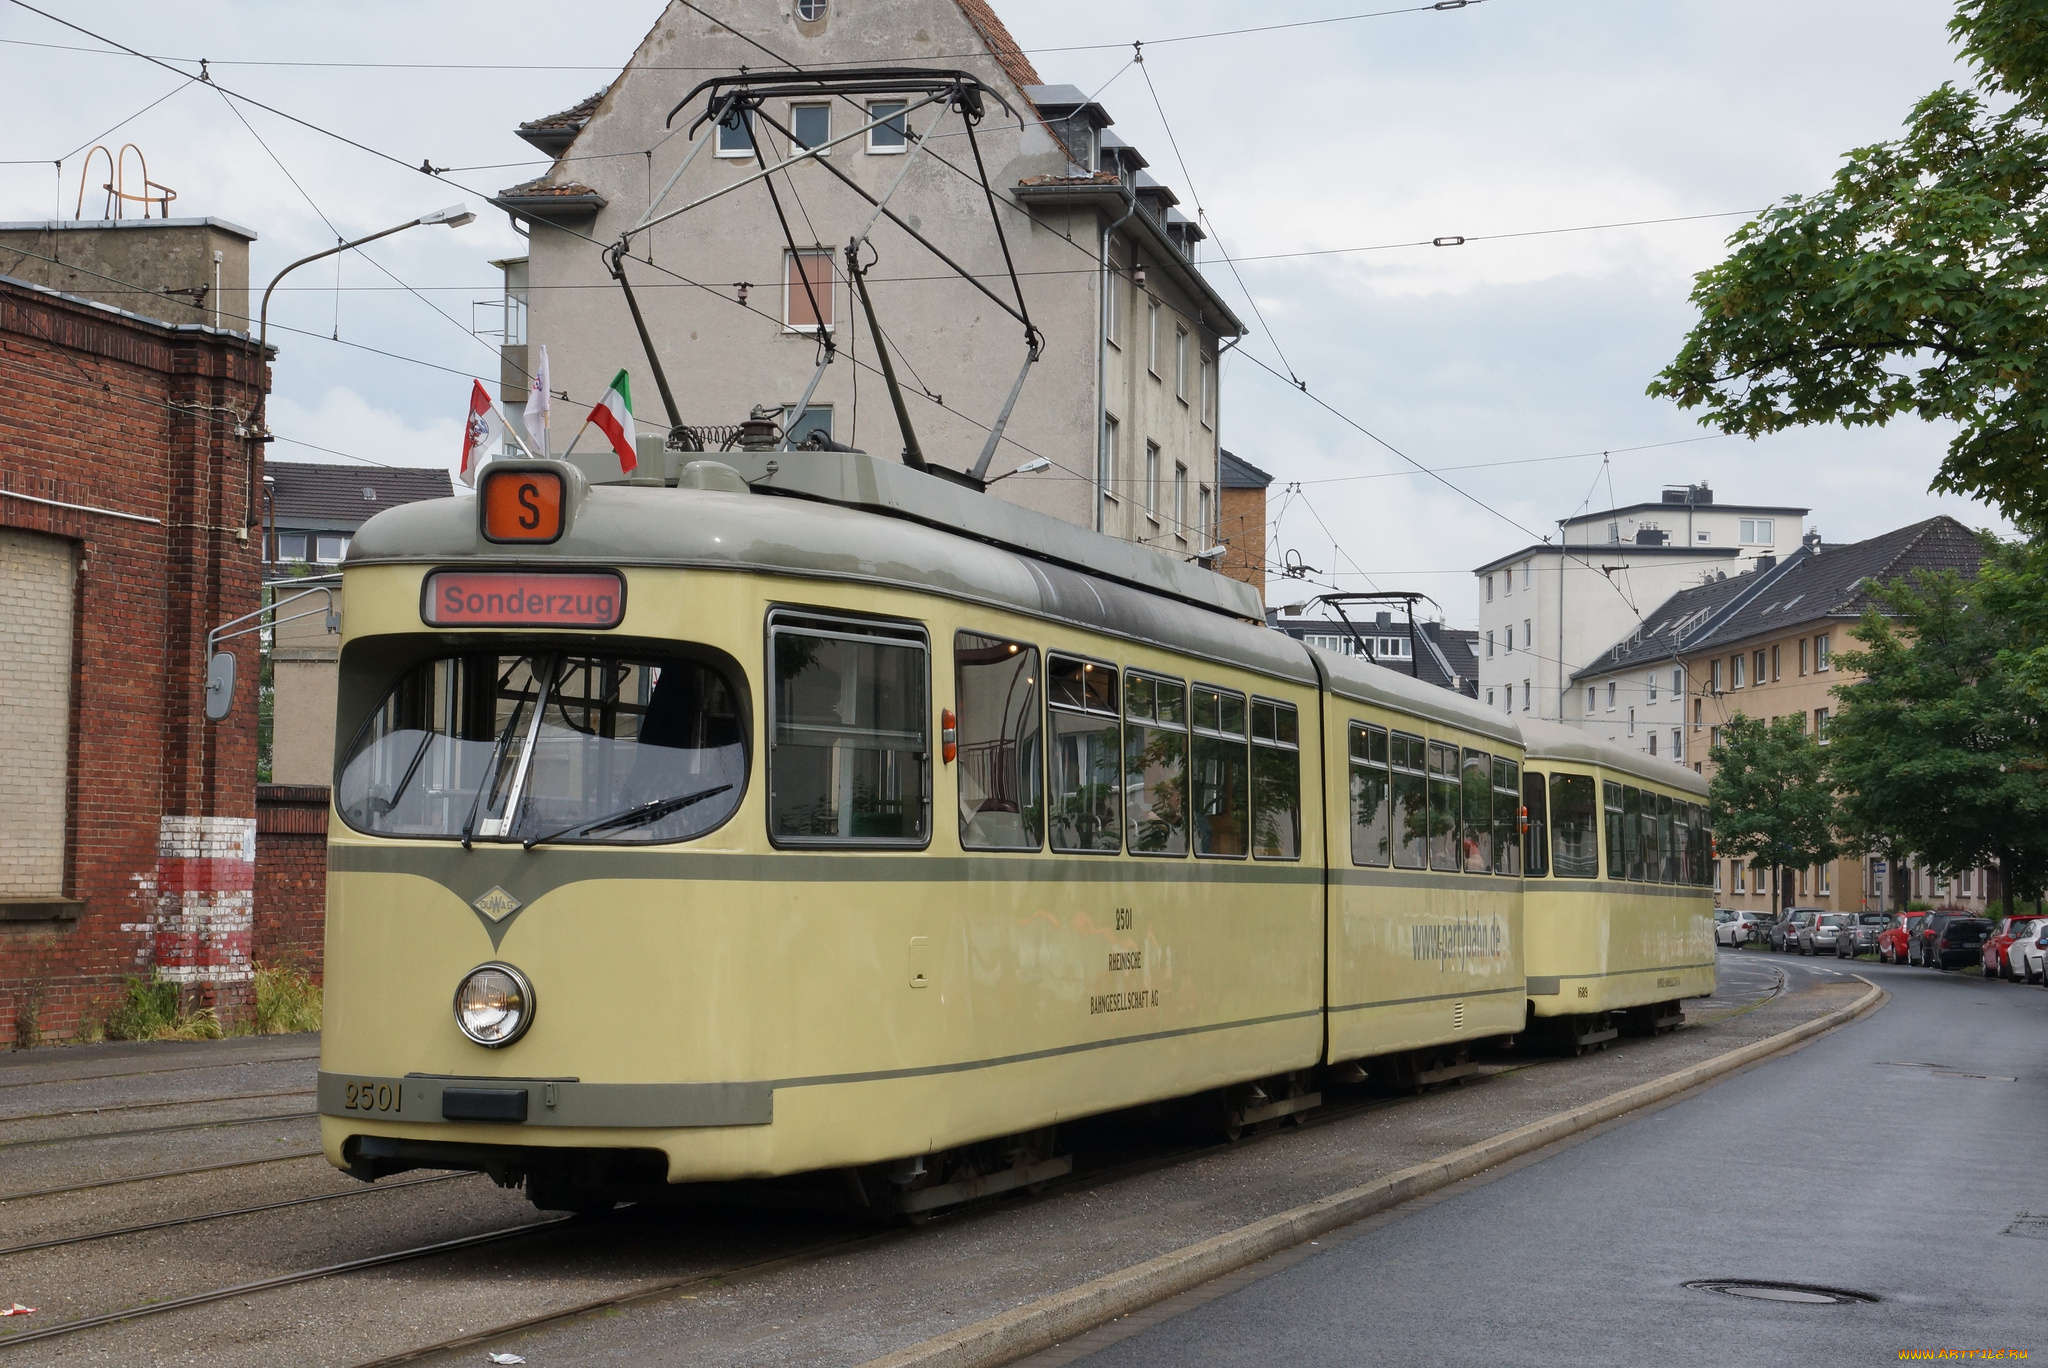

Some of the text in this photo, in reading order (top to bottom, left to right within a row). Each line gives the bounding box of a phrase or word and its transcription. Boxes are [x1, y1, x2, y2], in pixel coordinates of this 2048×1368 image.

[518, 483, 540, 530] S
[444, 586, 613, 623] Sonderzug
[480, 895, 514, 913] DUWAG
[1115, 907, 1133, 931] 2501
[1412, 910, 1501, 973] www.partybahn.de
[1108, 952, 1142, 972] RHEINISCHE
[1090, 989, 1159, 1015] BAHNGESELLSCHAFT AG
[345, 1080, 403, 1113] 2501
